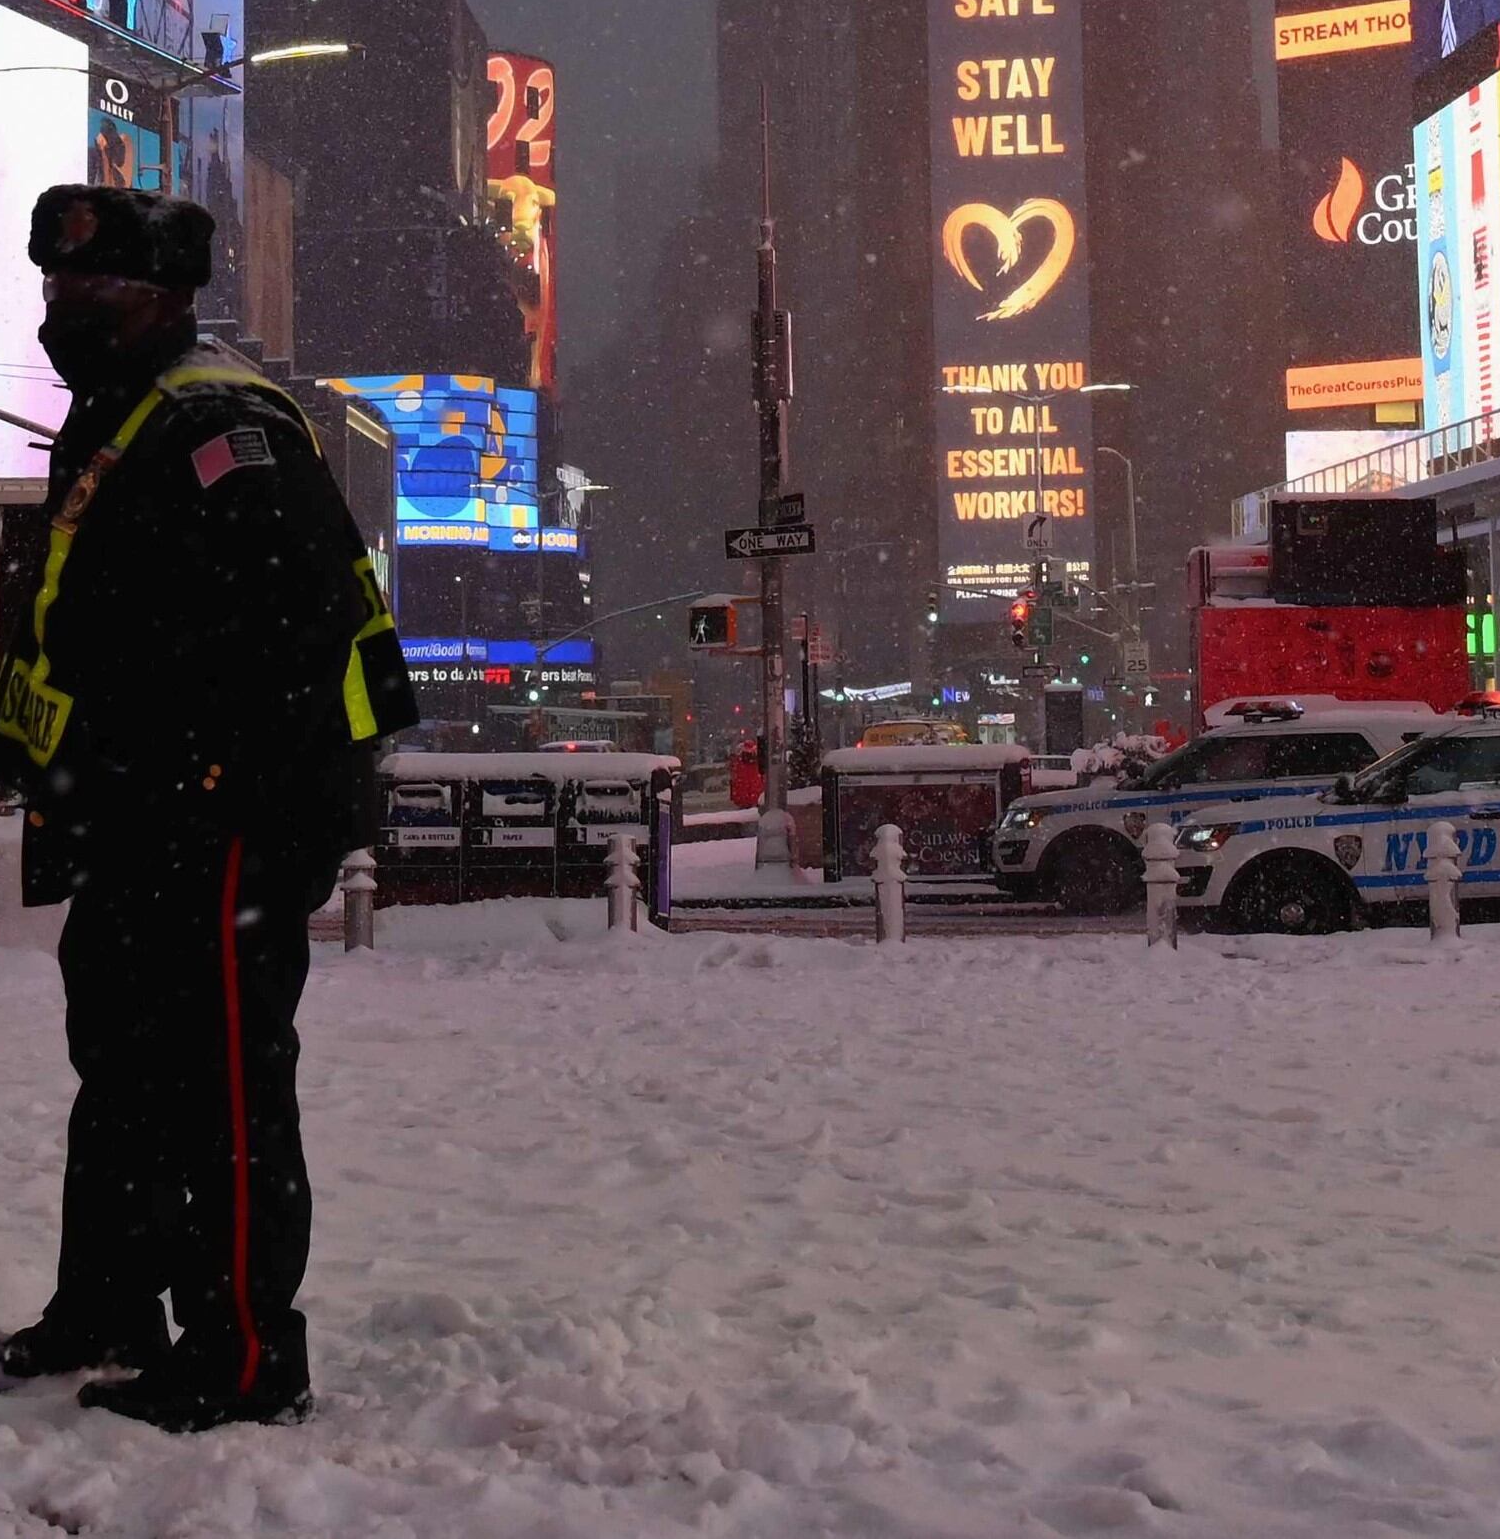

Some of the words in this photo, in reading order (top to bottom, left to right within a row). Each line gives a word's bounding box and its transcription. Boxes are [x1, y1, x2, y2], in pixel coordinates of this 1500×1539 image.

[1279, 19, 1358, 46] STREAM
[957, 57, 1055, 101] STAY
[100, 98, 134, 123] OAKLEY
[953, 114, 1064, 157] WELL
[943, 363, 1027, 392] THANK
[1035, 362, 1084, 389] YOU
[971, 407, 1003, 435] TO
[947, 446, 1084, 478] ESSENTIAL
[404, 526, 471, 541] MORNING
[512, 533, 531, 544] abc
[739, 536, 764, 550] ONE
[776, 533, 803, 547] WAY
[1027, 539, 1049, 548] ONLY
[433, 668, 448, 680] to
[1127, 659, 1148, 673] 25
[1266, 815, 1312, 831] POLICE
[909, 829, 942, 846] Can
[948, 832, 971, 845] we
